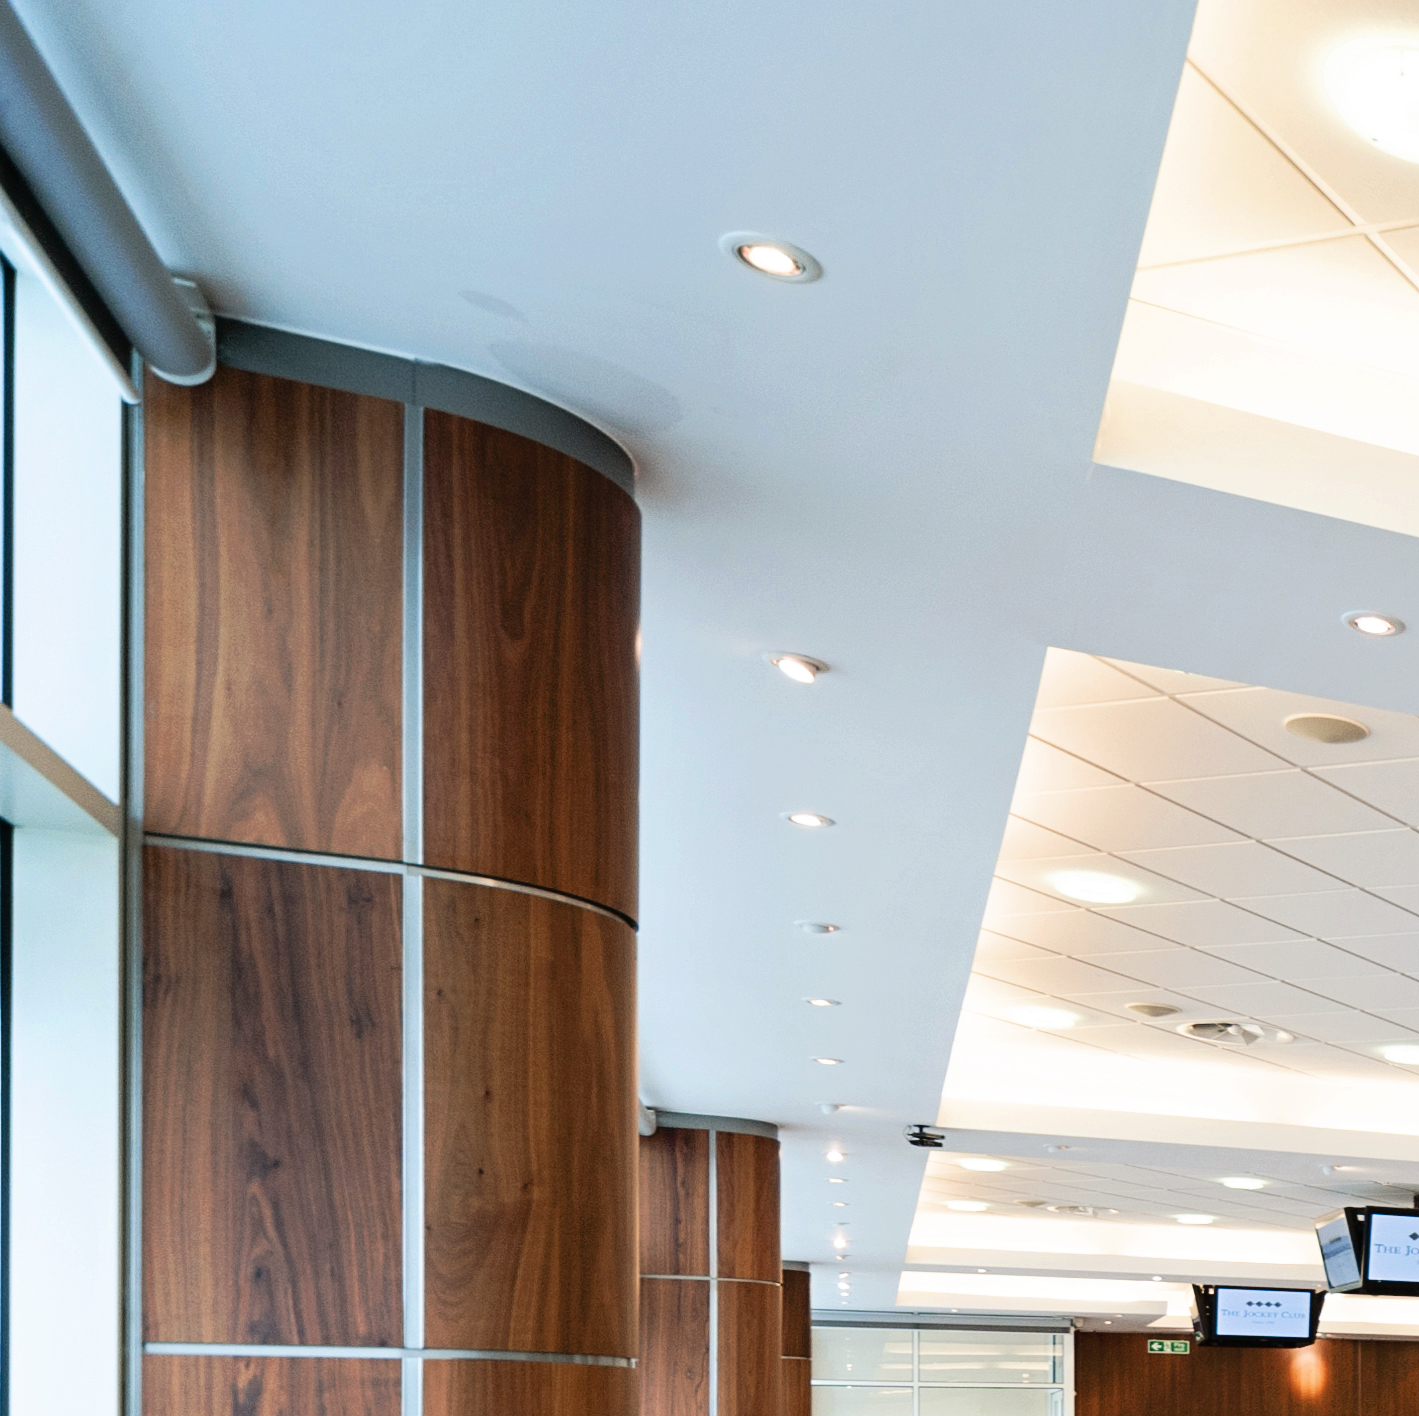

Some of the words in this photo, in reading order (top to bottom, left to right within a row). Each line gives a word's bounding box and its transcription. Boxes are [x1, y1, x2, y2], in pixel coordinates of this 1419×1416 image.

[1374, 1243, 1401, 1255] THE
[1220, 1308, 1239, 1317] THE
[1243, 1309, 1279, 1319] JOCKEY
[1281, 1311, 1306, 1320] CLUB
